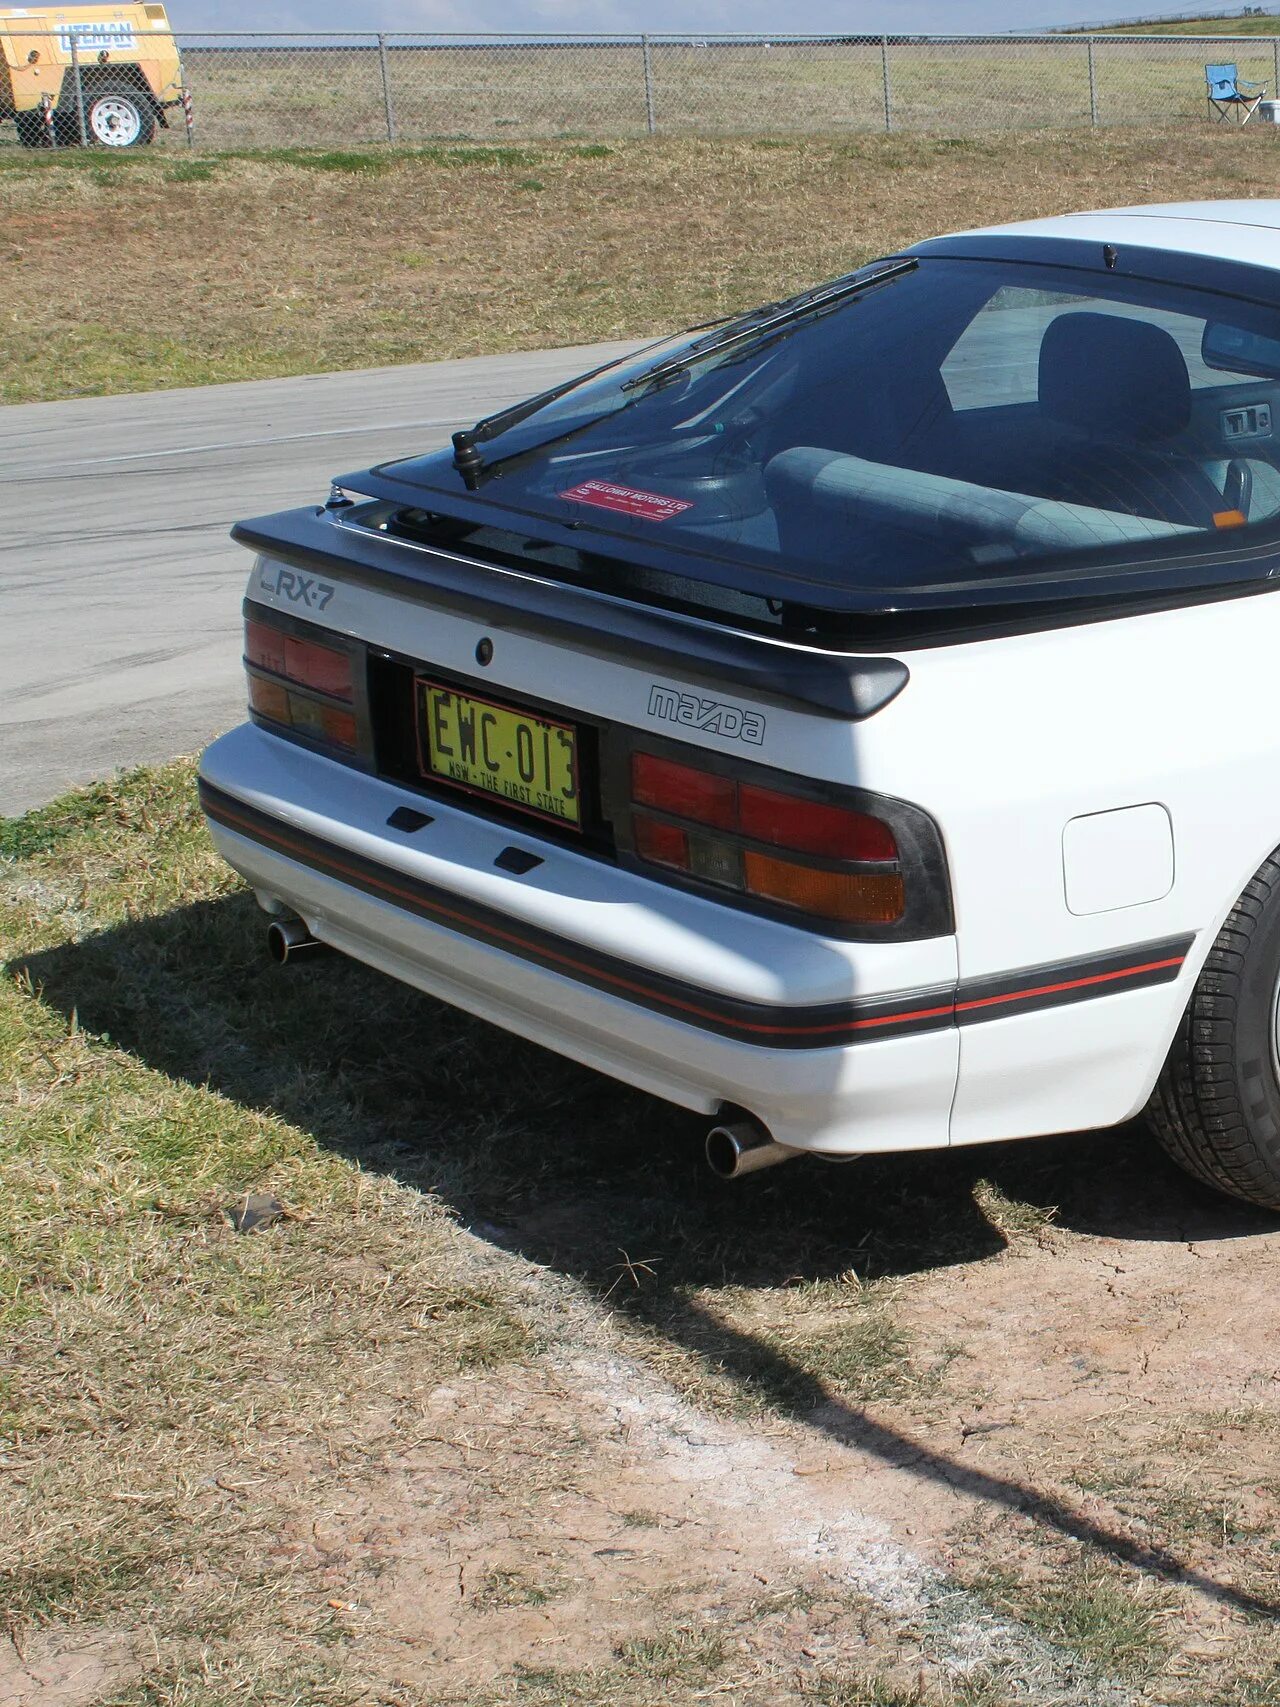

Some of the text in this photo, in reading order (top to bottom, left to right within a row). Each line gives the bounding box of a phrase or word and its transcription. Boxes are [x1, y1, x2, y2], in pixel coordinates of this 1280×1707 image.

[585, 482, 633, 497] GALLOWAY
[630, 493, 670, 506] MOTORS
[276, 569, 335, 611] RX-7
[648, 685, 766, 746] mazda
[449, 761, 470, 783] NSW
[480, 771, 499, 792] THE
[505, 780, 531, 803] FIRST
[538, 793, 566, 817] STATE
